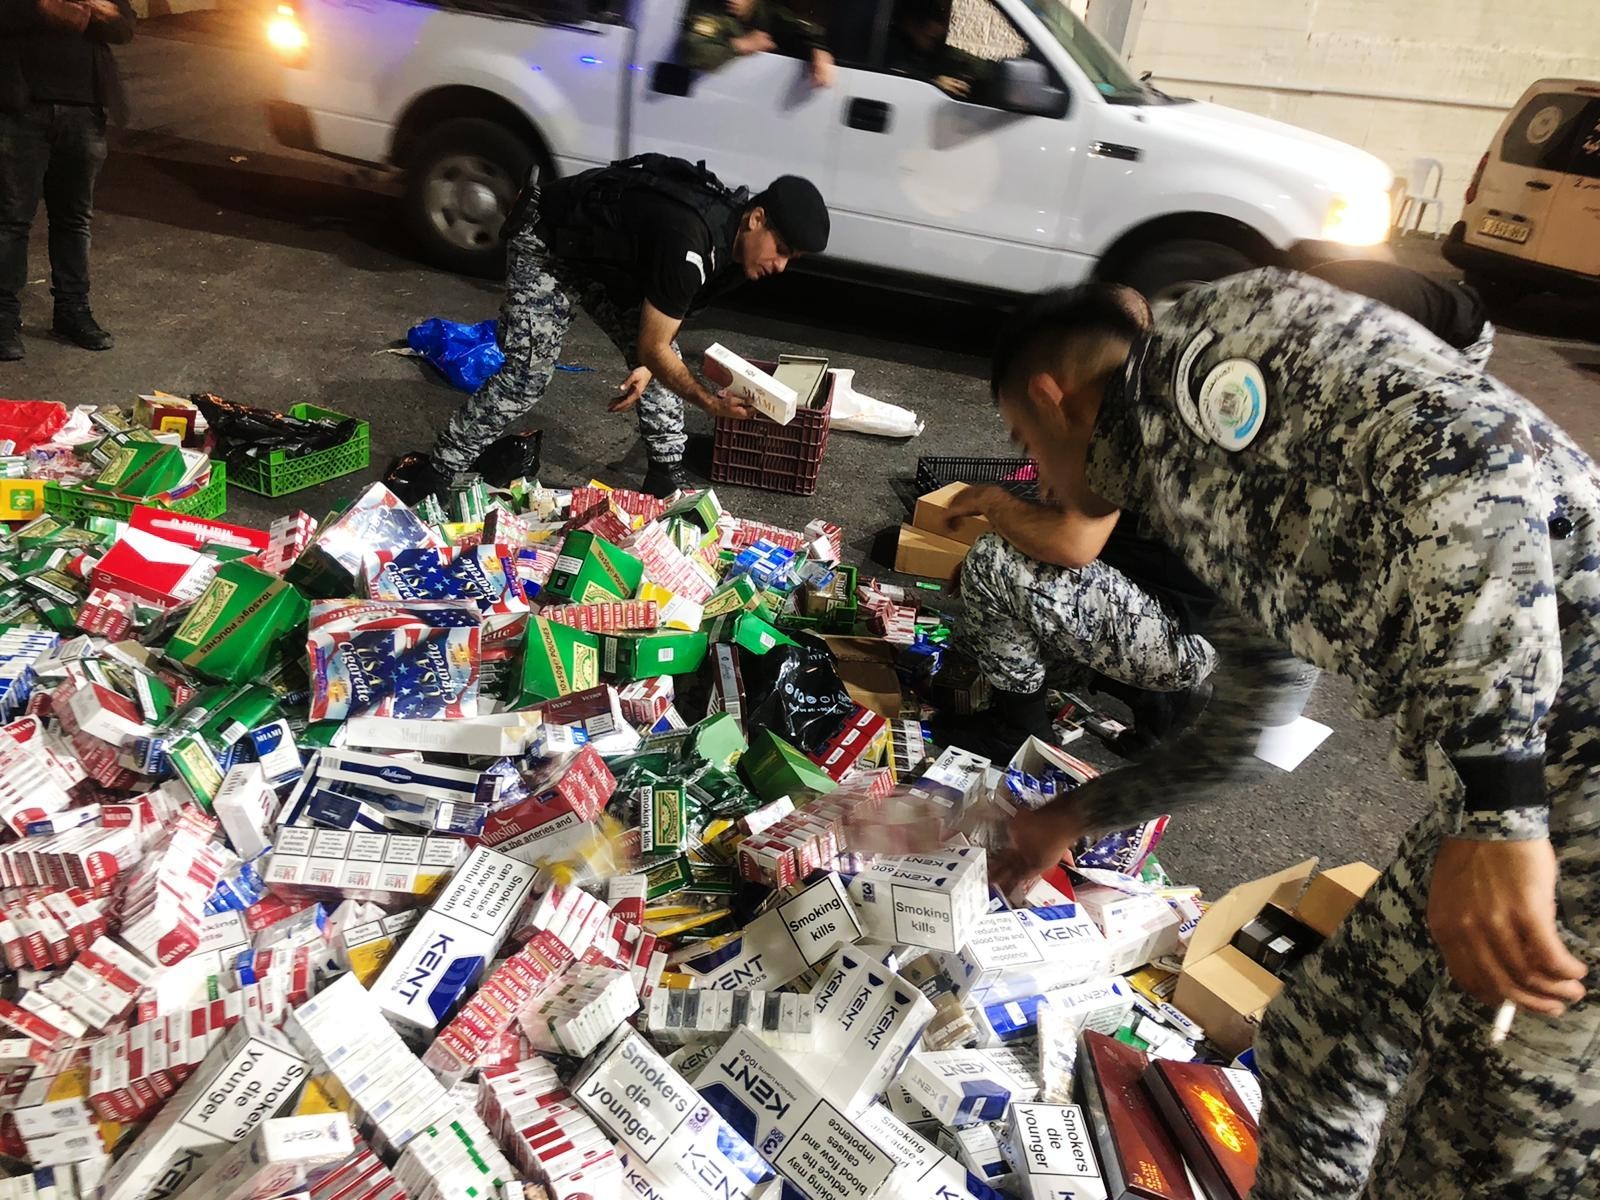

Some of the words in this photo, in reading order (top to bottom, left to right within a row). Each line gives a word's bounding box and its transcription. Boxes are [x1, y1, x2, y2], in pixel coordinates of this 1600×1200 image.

[200, 622, 238, 656] POUCHES
[338, 641, 370, 703] Cigarette
[356, 648, 384, 686] USA
[415, 658, 441, 697] USA
[428, 642, 458, 705] Cigarette
[256, 728, 282, 742] MIAMI
[642, 788, 652, 829] Smoking
[480, 822, 522, 846] Winston
[509, 838, 525, 849] the
[524, 825, 556, 845] arteries
[556, 816, 573, 830] and
[643, 830, 652, 849] kills
[464, 850, 491, 883] painful
[498, 863, 513, 881] can
[905, 856, 944, 867] KENT
[479, 865, 497, 888] slow
[862, 882, 872, 895] 3
[891, 871, 932, 883] KENT
[443, 884, 467, 912] death
[464, 888, 479, 909] and
[481, 883, 500, 911] cause
[487, 874, 524, 918] Smoking
[788, 897, 841, 933] Smoking
[896, 901, 950, 923] Smoking
[1017, 911, 1028, 921] 3
[810, 921, 836, 942] kills
[911, 921, 936, 934] kills
[1040, 924, 1090, 942] KENT
[539, 945, 562, 969] MIAMI
[550, 938, 573, 960] MIAMI
[399, 933, 455, 1005] KENT
[493, 989, 519, 1013] MIAMI
[506, 977, 529, 1000] MIAMI
[816, 970, 847, 1013] KENT
[842, 987, 872, 1031] KENT
[462, 1026, 488, 1049] MIAMI
[868, 1006, 899, 1050] KENT
[451, 1038, 476, 1061] MIAMI
[678, 1044, 716, 1073] KENT
[739, 1049, 758, 1070] 100's
[621, 1041, 688, 1113] Smokers
[940, 1062, 991, 1077] KENT
[198, 1048, 263, 1123] younger
[235, 1081, 263, 1108] die
[625, 1082, 652, 1109] die
[720, 1055, 791, 1120] KENT
[911, 1076, 938, 1098] KENT
[233, 1064, 304, 1140] Smokers
[587, 1080, 657, 1147] younger
[694, 1107, 709, 1123] 3
[763, 1137, 779, 1156] 3
[801, 1132, 821, 1151] and
[828, 1118, 876, 1165] impotence
[881, 1116, 927, 1154] Smoking
[885, 1134, 917, 1158] cause
[1019, 1109, 1048, 1169] younger
[1046, 1127, 1061, 1150] die
[1060, 1109, 1089, 1173] Smokers
[802, 1151, 819, 1169] the
[820, 1149, 840, 1172] flow
[826, 1136, 860, 1167] causes
[787, 1156, 809, 1177] may
[818, 1164, 851, 1197] reduce
[839, 1168, 868, 1196] blood
